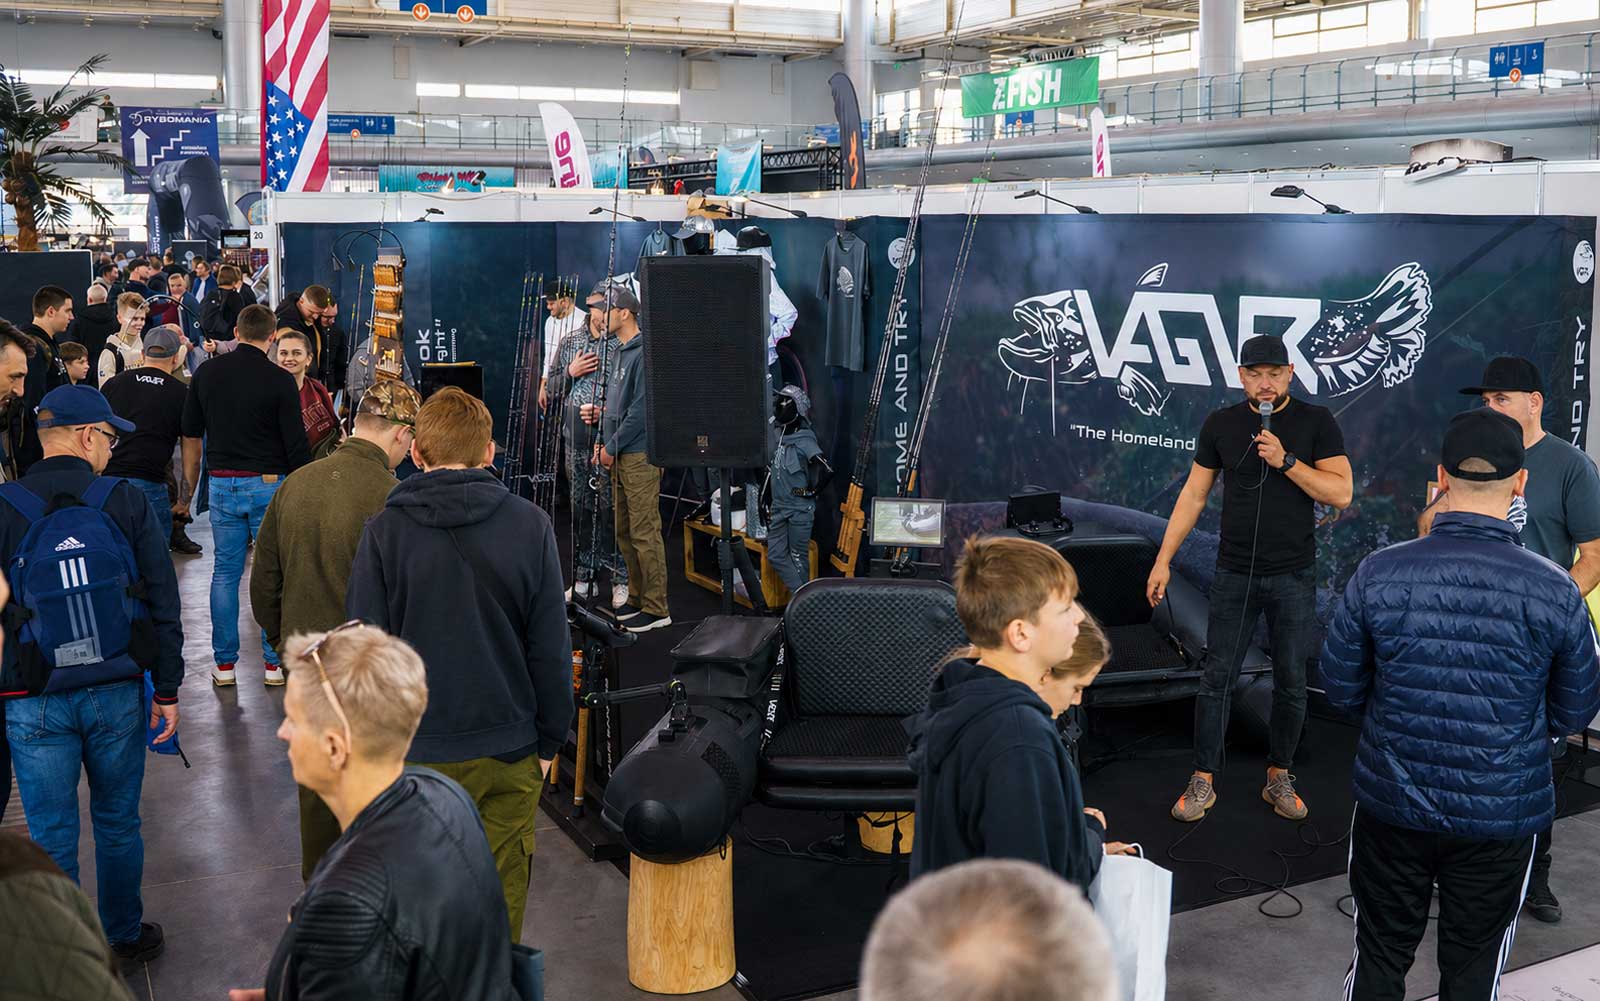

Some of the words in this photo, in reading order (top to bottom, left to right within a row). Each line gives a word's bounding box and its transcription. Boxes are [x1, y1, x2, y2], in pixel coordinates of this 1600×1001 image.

[143, 115, 211, 124] RYBOMANIA
[253, 231, 264, 240] 20
[1572, 316, 1586, 390] TRY
[895, 353, 908, 412] AND
[894, 422, 907, 494] OME
[1070, 423, 1106, 440] "The
[1111, 428, 1196, 451] Homeland
